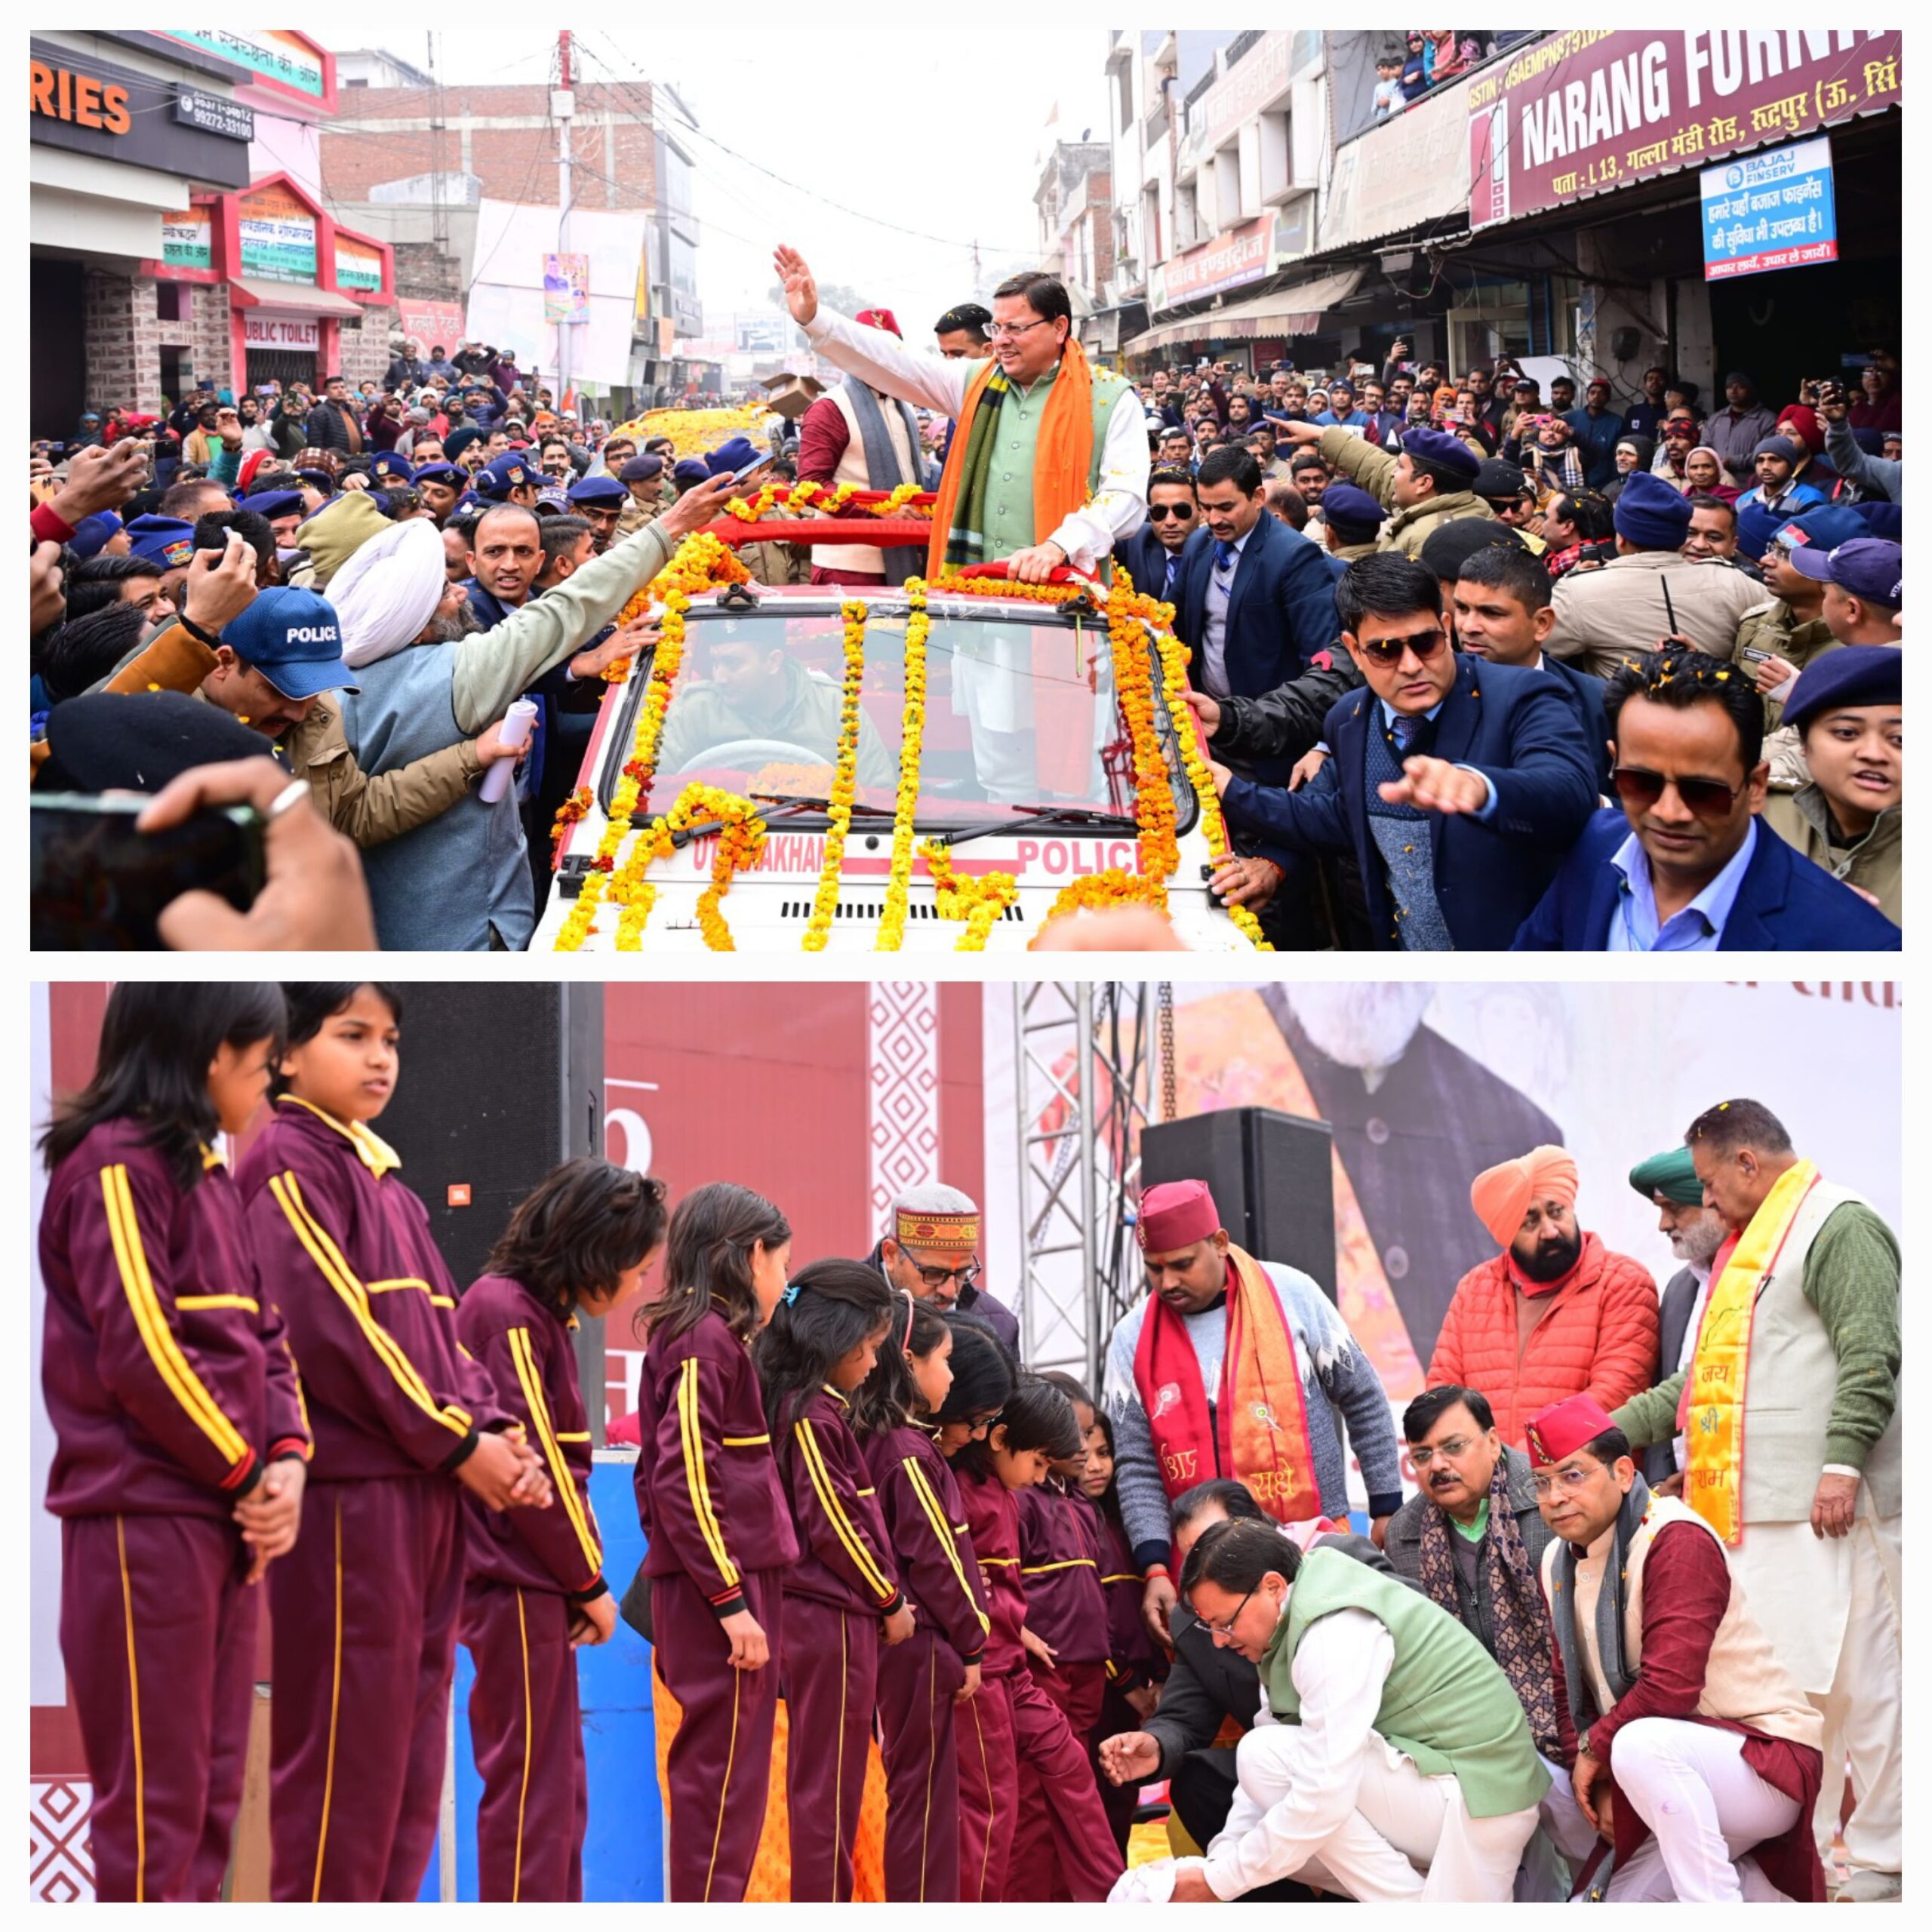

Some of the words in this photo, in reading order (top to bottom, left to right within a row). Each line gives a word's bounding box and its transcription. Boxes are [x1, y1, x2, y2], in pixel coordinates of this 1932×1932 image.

[30, 60, 131, 135] RIES
[1469, 75, 1497, 109] GSTIN
[1521, 41, 1669, 170] NARANG
[1684, 30, 1885, 108] FURN
[194, 108, 251, 138] 99272-33100
[1552, 172, 1577, 195] पता
[1600, 155, 1623, 180] 13,
[1626, 140, 1669, 171] गल्ला
[1672, 123, 1704, 156] मंडी
[1708, 115, 1746, 144] रोड,
[1746, 150, 1795, 172] BAJAJ
[1746, 163, 1795, 184] FINSERV
[1708, 198, 1730, 224] हमारे
[1750, 190, 1780, 212] बजाज
[1712, 226, 1724, 250] की
[1726, 223, 1754, 256] सुविधा
[1756, 217, 1768, 241] भी
[1770, 216, 1806, 238] उपलब्ध
[1789, 248, 1799, 263] ले
[245, 321, 277, 341] UBLIC
[279, 325, 318, 345] TOILET
[287, 626, 337, 643] POLICE
[1701, 1364, 1730, 1383] जय
[1700, 1407, 1721, 1434] श्री
[1250, 1457, 1296, 1501] राधे
[1694, 1468, 1727, 1490] राम
